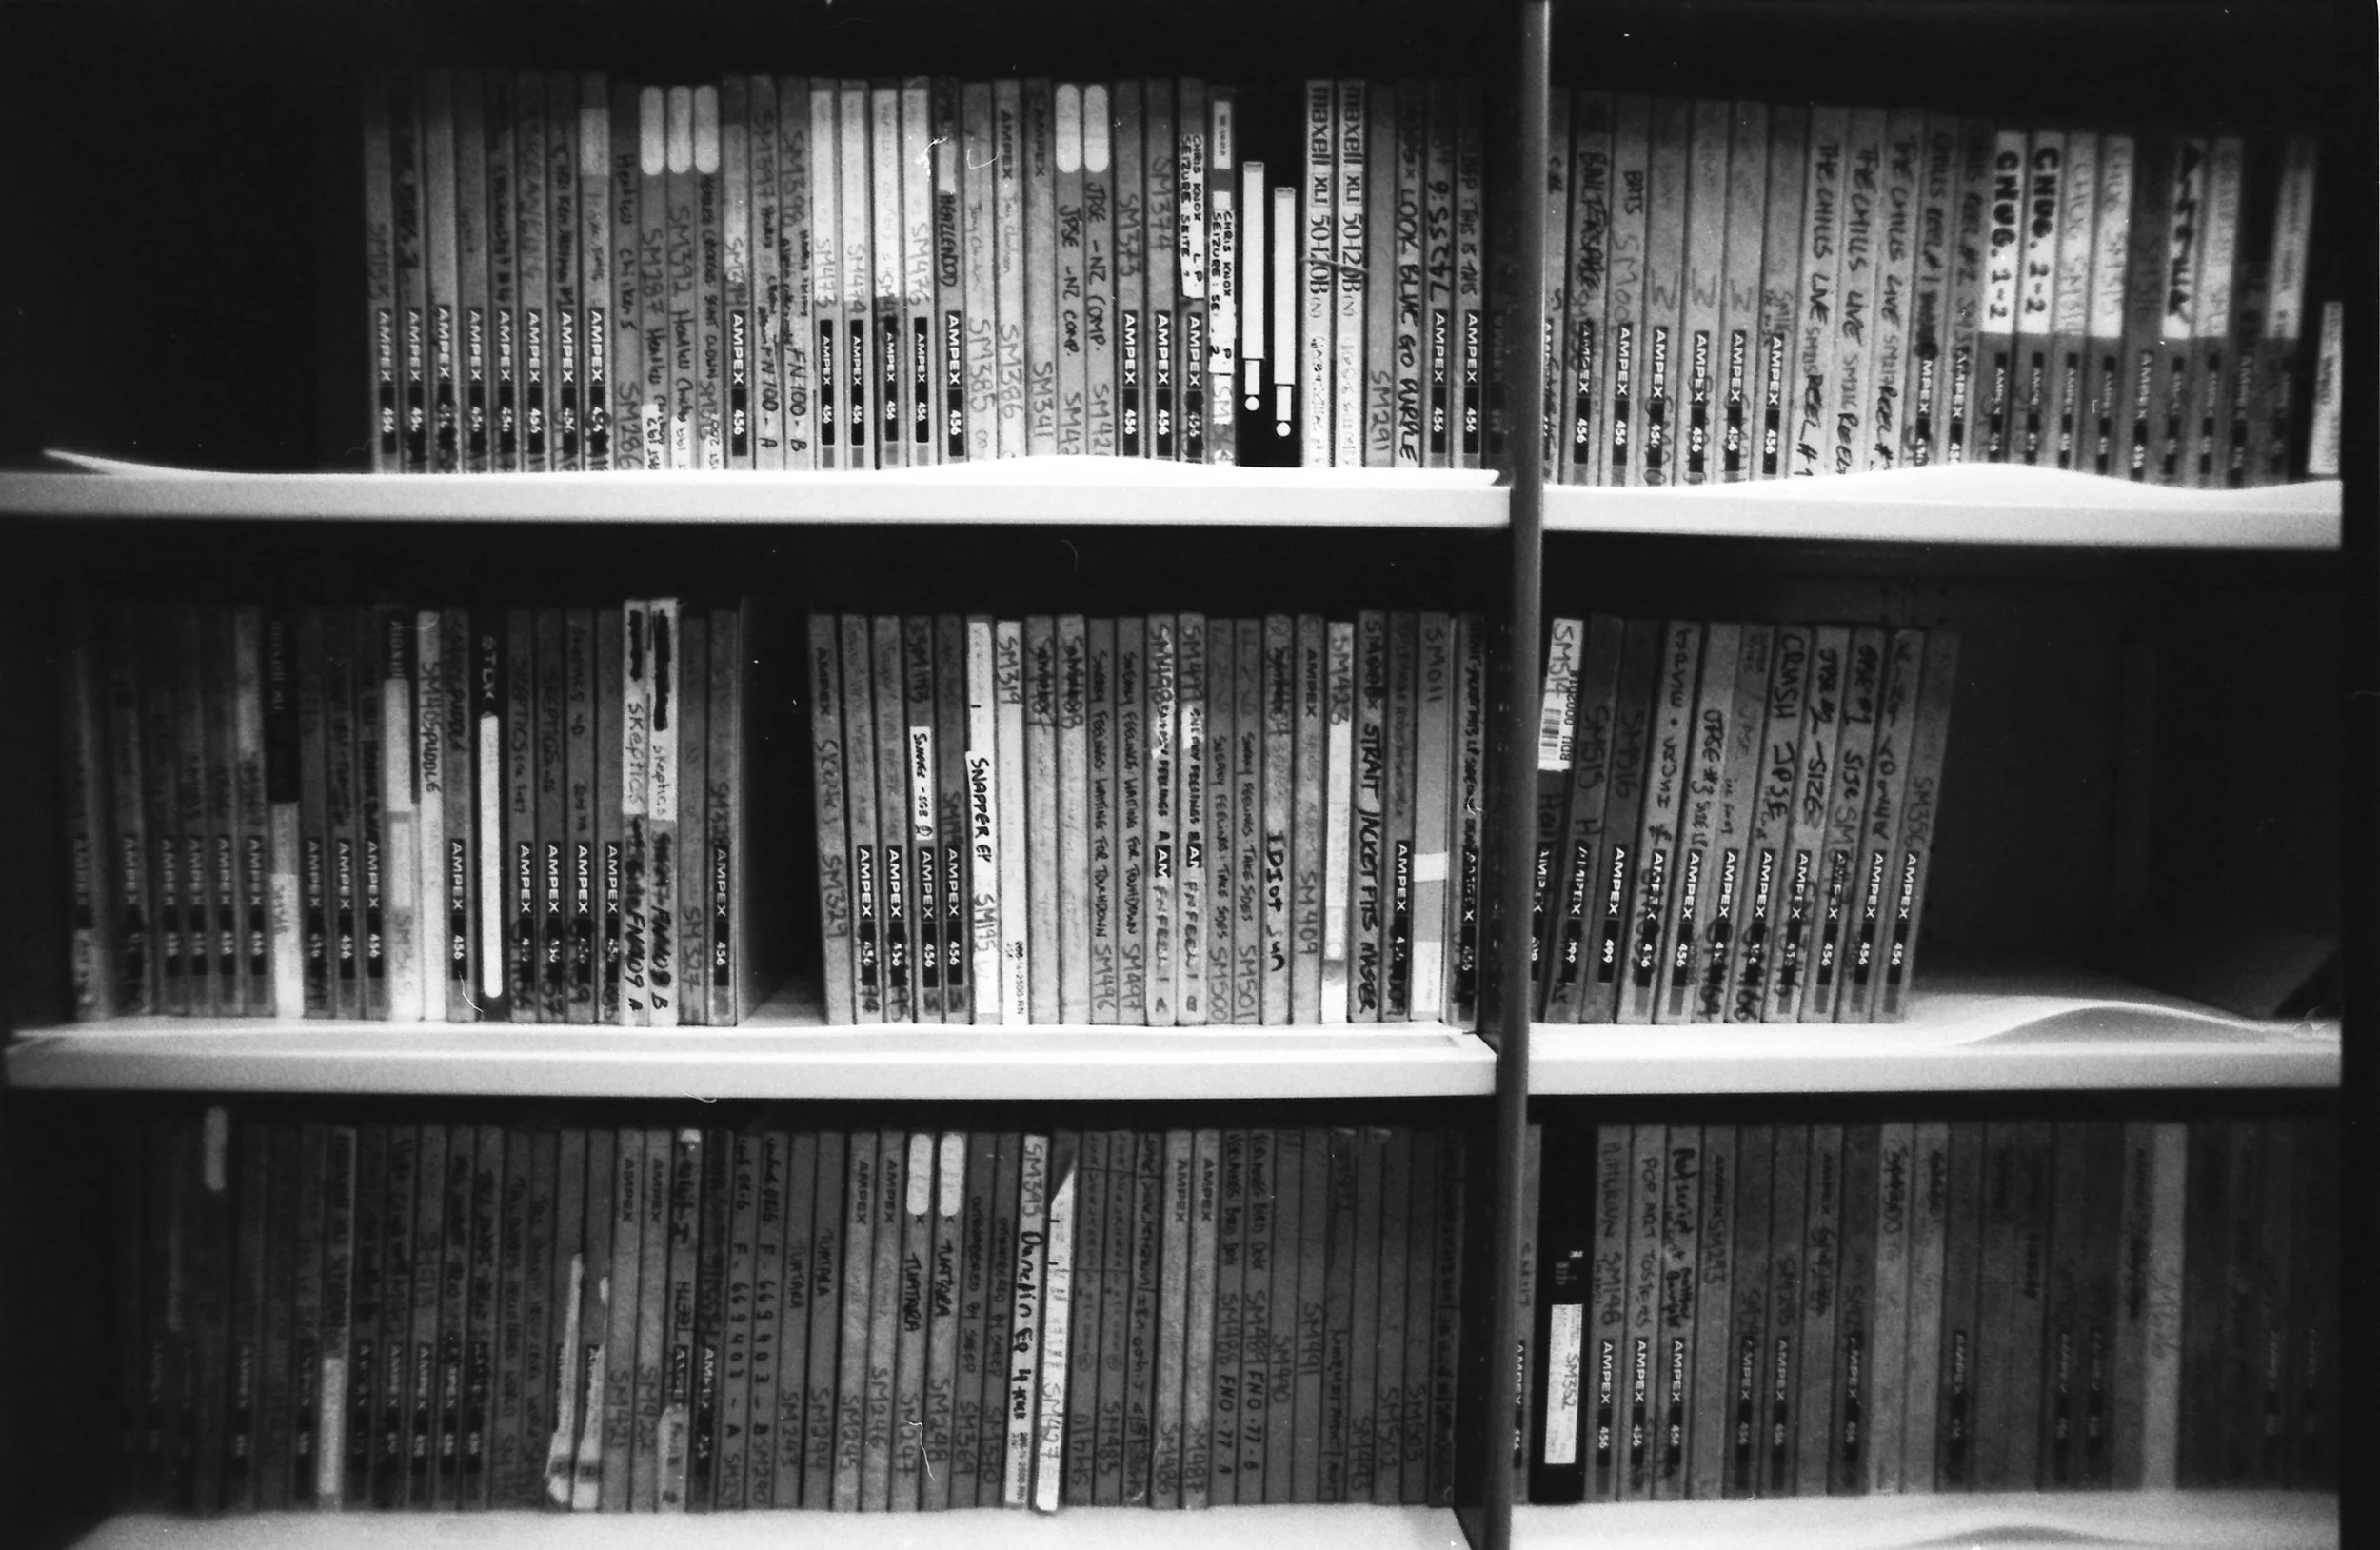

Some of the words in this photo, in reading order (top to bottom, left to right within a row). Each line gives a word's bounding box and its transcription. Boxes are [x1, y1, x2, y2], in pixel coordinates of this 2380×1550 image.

[1002, 109, 1013, 180] AMPEX
[1192, 135, 1202, 174] CHRIS
[1312, 87, 1332, 165] maxell
[1343, 87, 1363, 164] maxell
[1180, 135, 1191, 204] SEIZURE
[1623, 170, 1642, 215] BATS
[1816, 143, 1840, 184] THE
[1854, 145, 1879, 190] THE
[1117, 192, 1141, 277] SM373
[1149, 154, 1173, 250] SM374
[1180, 214, 1191, 258] SEITE
[1192, 183, 1202, 223] KNOX
[1222, 211, 1233, 253] CHRIS
[1398, 189, 1418, 255] LOOK
[1813, 189, 1834, 260] CHILLS
[1848, 194, 1868, 272] CHILLS
[1888, 187, 1906, 263] CHILLS
[641, 228, 663, 315] SM287
[671, 205, 692, 297] SM392
[1212, 212, 1221, 277] SEIZURE
[1223, 261, 1233, 297] KNOX
[1399, 265, 1419, 328] BLUE
[1809, 273, 1834, 324] LIVE
[1843, 290, 1868, 346] LIVE
[1882, 275, 1904, 329] LIVE
[379, 310, 392, 382] AMPEX
[408, 310, 421, 382] AMPEX
[469, 310, 482, 382] AMPEX
[528, 311, 541, 383] AMPEX
[561, 311, 573, 383] AMPEX
[732, 312, 745, 385] AMPEX
[823, 335, 831, 385] AMPEX
[852, 335, 862, 385] AMPEX
[886, 332, 895, 383] AMPEX
[917, 333, 925, 383] AMPEX
[949, 314, 961, 385] AMPEX
[968, 317, 995, 413] SM385
[999, 324, 1021, 419] SM386
[1124, 312, 1137, 385] AMPEX
[1158, 313, 1170, 385] AMPEX
[1189, 315, 1200, 386] AMPEX
[1399, 335, 1417, 367] GO
[1617, 327, 1631, 395] AMPEX
[1653, 328, 1667, 399] AMPEX
[1031, 361, 1053, 438] SM341
[1370, 369, 1390, 451] SM291
[1398, 379, 1418, 461] PURPLE
[1433, 407, 1445, 432] 456
[1465, 407, 1478, 432] 456
[1692, 427, 1703, 452] 456
[1727, 426, 1740, 451] 456
[817, 647, 830, 718] AMPEX
[997, 636, 1021, 705] SM319
[1425, 627, 1445, 703] SM011
[1773, 632, 1805, 719] CRUSH
[1362, 723, 1383, 799] STRAIT
[971, 757, 990, 838] SNAPPER
[367, 841, 380, 908] AMPEX
[452, 842, 465, 910] AMPEX
[1094, 837, 1110, 862] FOR
[1126, 836, 1141, 863] FOR
[1356, 808, 1382, 880] JACKET
[1396, 844, 1408, 912] AMPEX
[520, 845, 532, 914] AMPEX
[577, 845, 589, 914] AMPEX
[717, 848, 727, 917] AMPEX
[823, 855, 847, 939] SM329
[888, 848, 902, 917] AMPEX
[1298, 870, 1319, 956] SM409
[682, 906, 704, 992] SM327
[922, 943, 935, 968] 456
[948, 940, 960, 965] 456
[1095, 944, 1115, 1010] SM496
[1124, 944, 1144, 1011] SM497
[1236, 944, 1259, 1019] SM501
[1601, 939, 1617, 964] 499
[1675, 943, 1689, 968] 456
[1820, 943, 1834, 967] 456
[1858, 942, 1872, 965] 456
[1891, 942, 1905, 966] 456
[1210, 947, 1229, 1021] SM500
[651, 1158, 664, 1223] AMPEX
[884, 1159, 897, 1223] AMPEX
[1022, 1143, 1043, 1219] SM395
[1200, 1158, 1213, 1222] AMPEX
[1642, 1157, 1657, 1193] POP
[1642, 1202, 1656, 1239] ART
[1775, 1340, 1789, 1401] AMPEX
[868, 1366, 889, 1448] SM246
[928, 1378, 951, 1463] SM248
[1098, 1401, 1119, 1477] SM483
[1598, 1426, 1610, 1449] 456
[1632, 1423, 1643, 1448] 456
